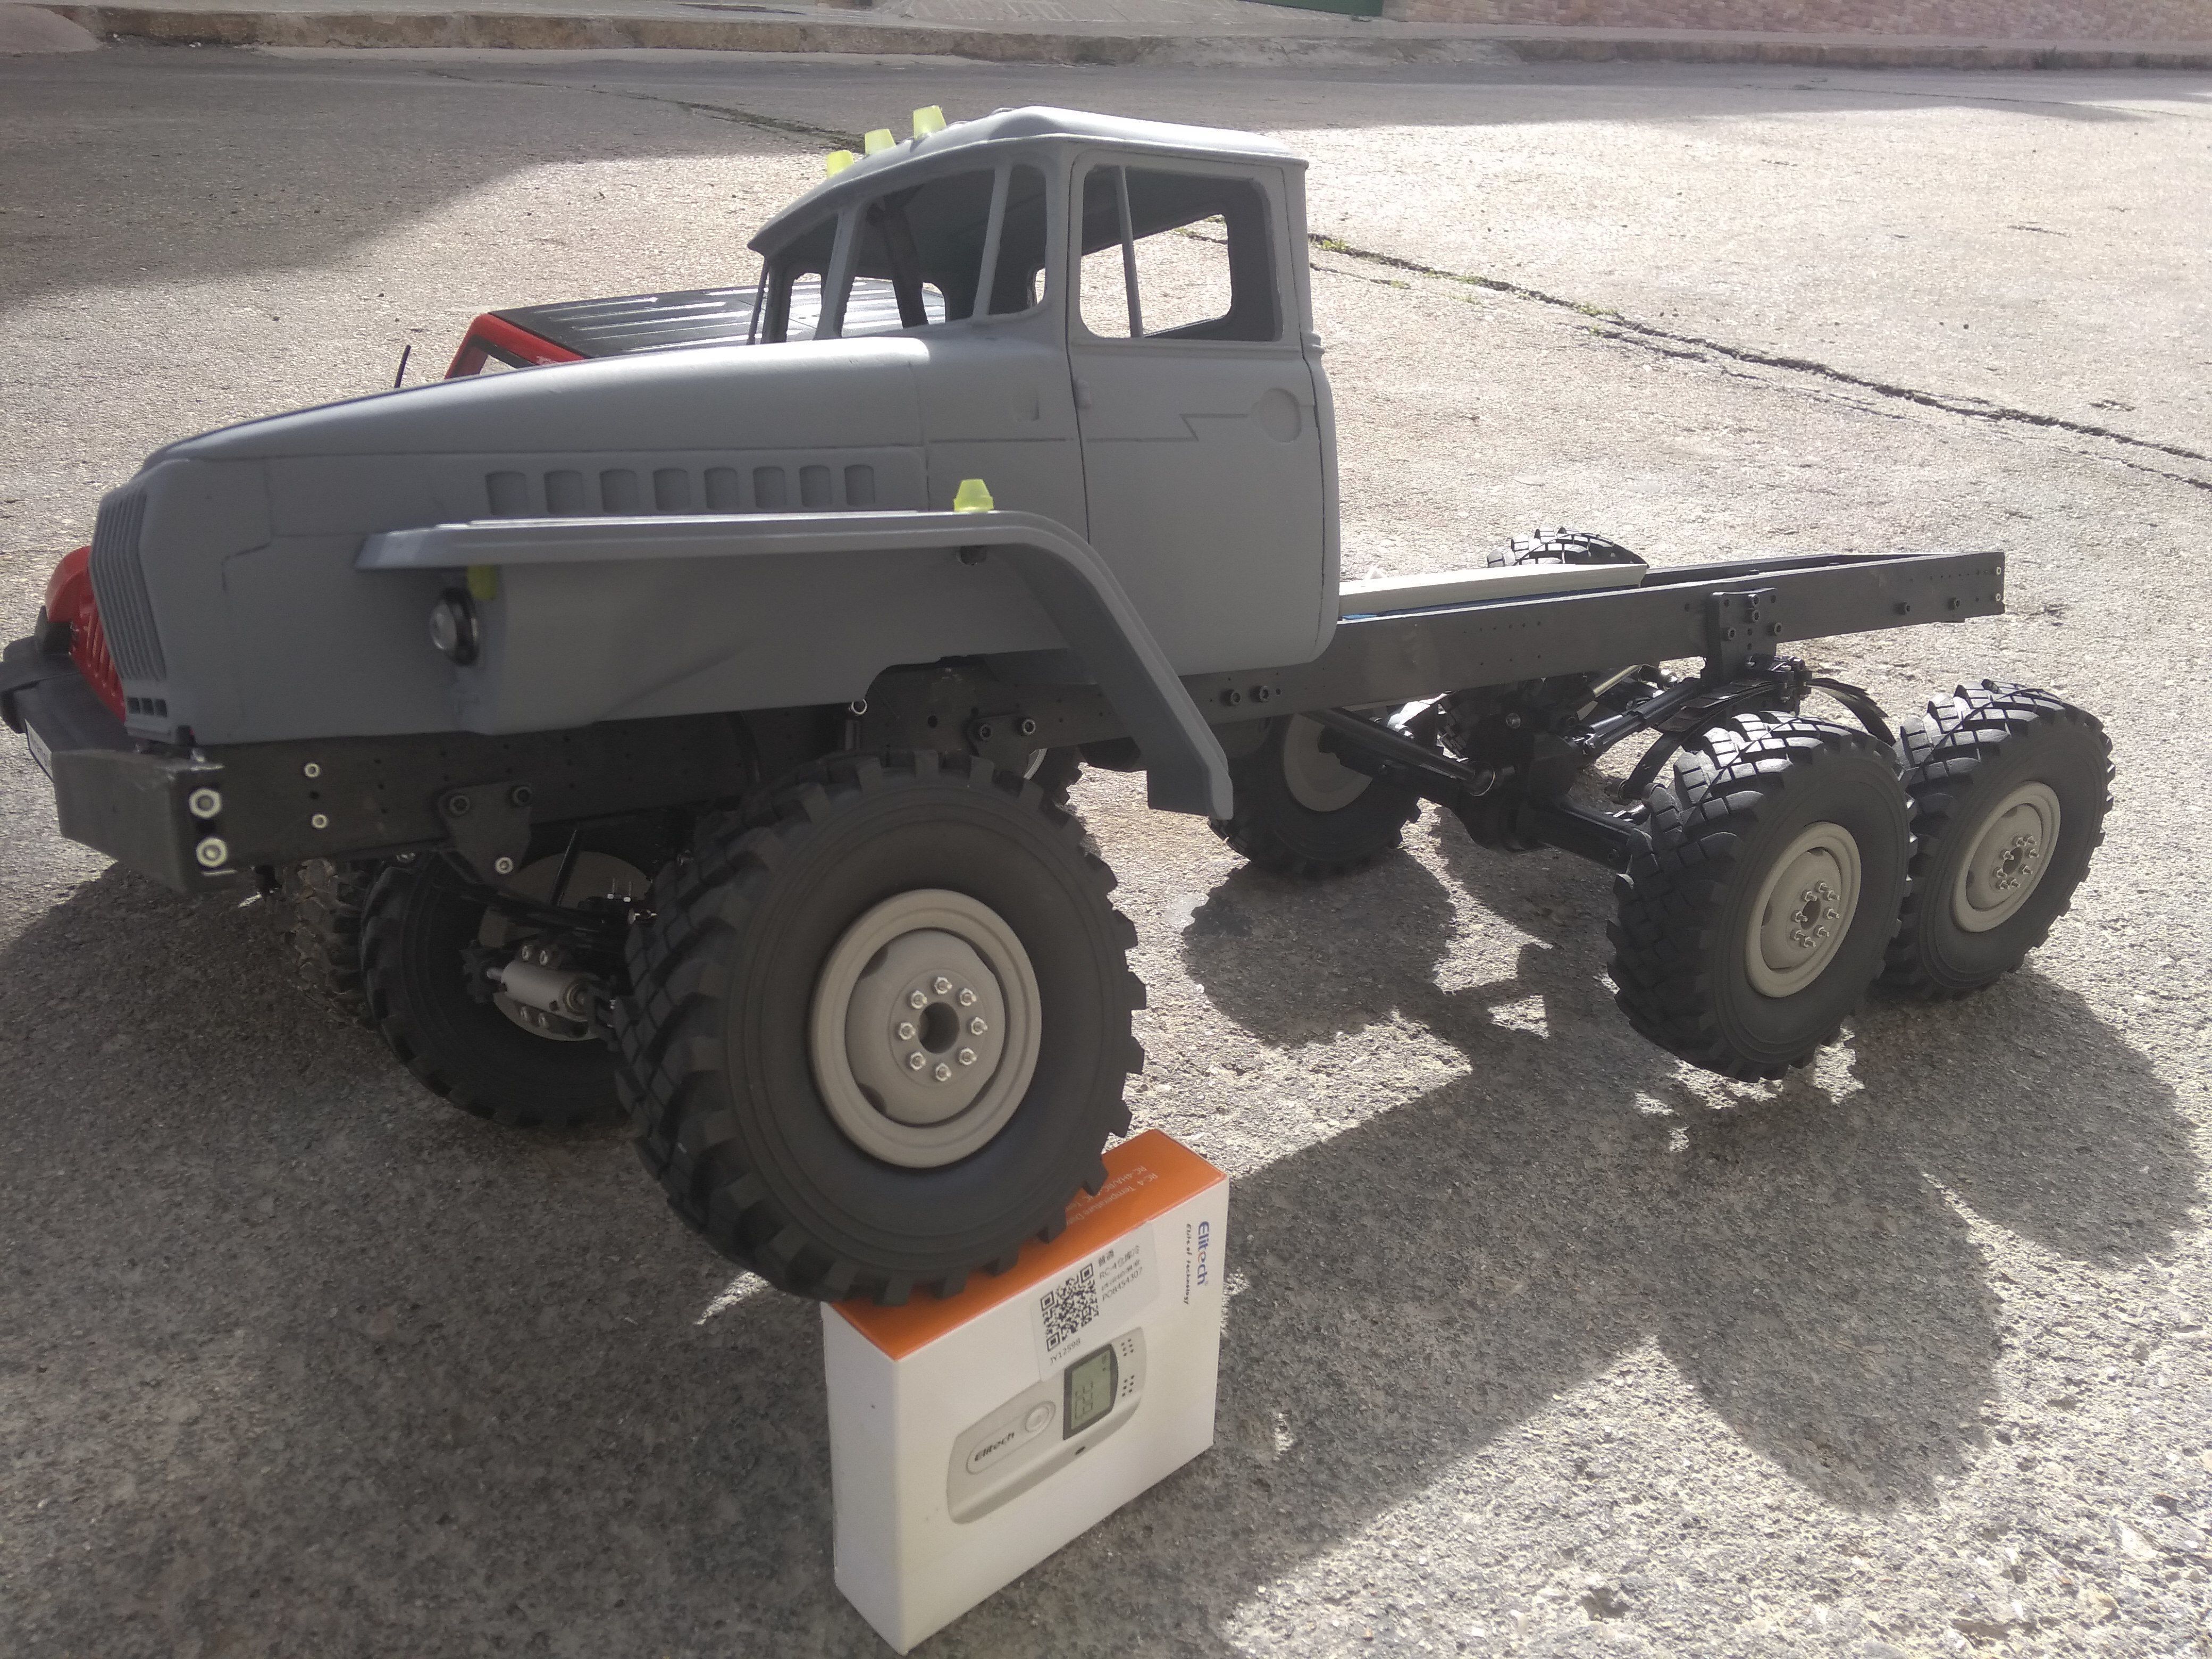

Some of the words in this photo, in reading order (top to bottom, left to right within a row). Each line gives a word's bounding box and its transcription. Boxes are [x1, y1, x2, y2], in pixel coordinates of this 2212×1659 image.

[1137, 1173, 1158, 1186] RC-4
[1186, 1246, 1193, 1255] of
[1197, 1221, 1209, 1285] Elitech
[974, 1432, 1015, 1461] Elitech
